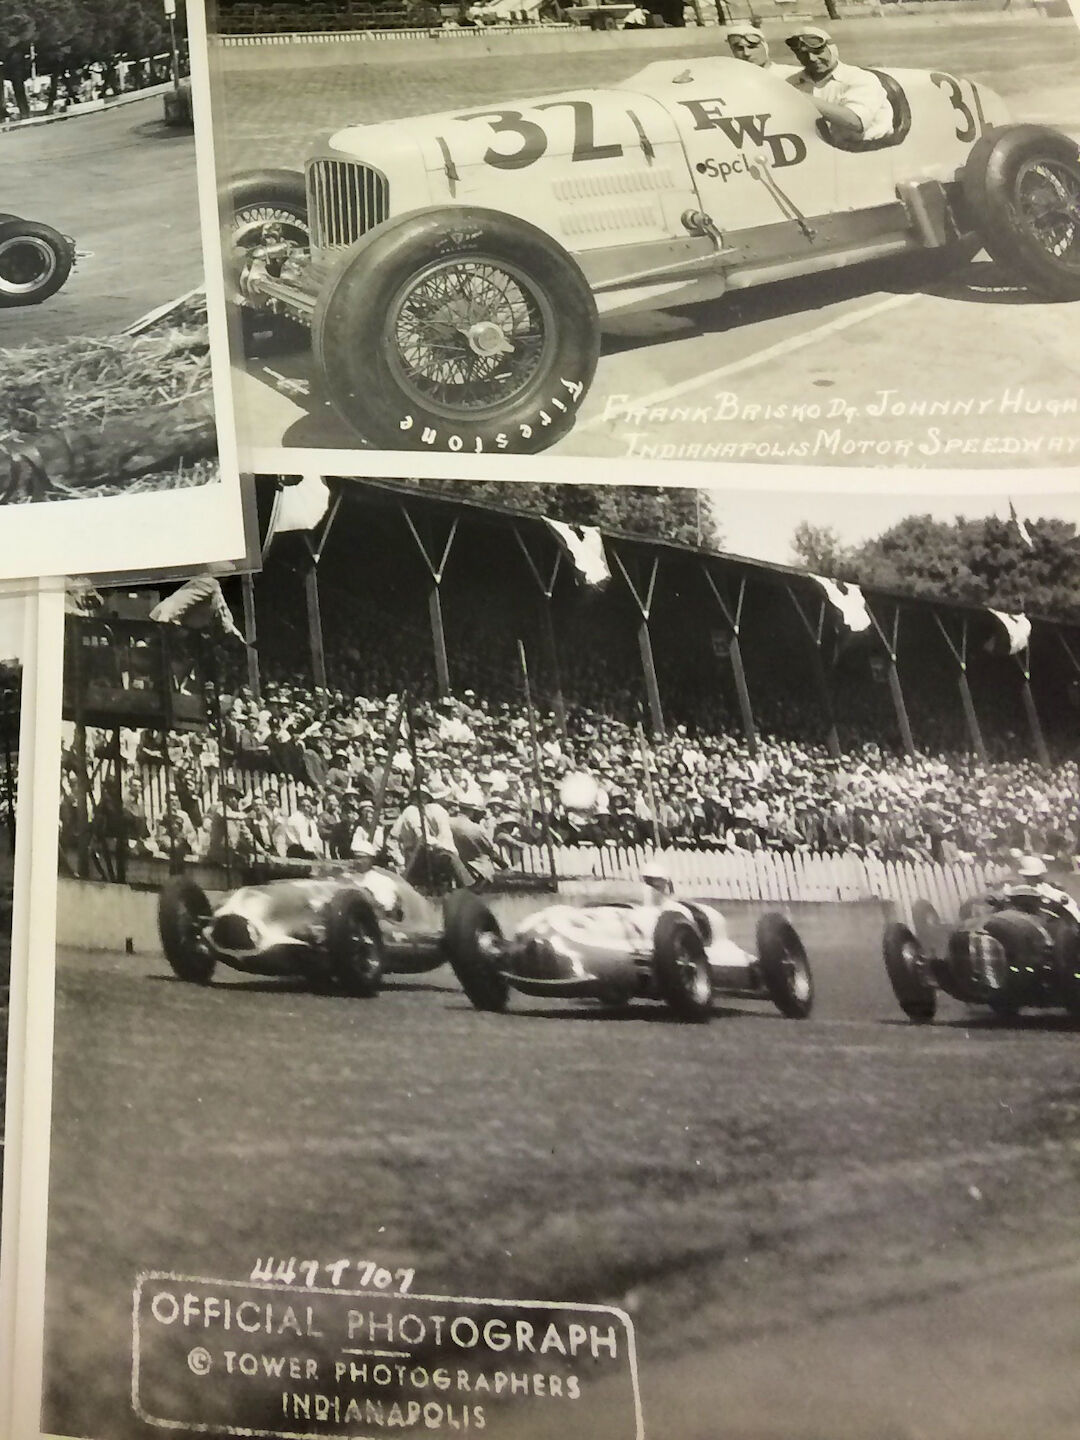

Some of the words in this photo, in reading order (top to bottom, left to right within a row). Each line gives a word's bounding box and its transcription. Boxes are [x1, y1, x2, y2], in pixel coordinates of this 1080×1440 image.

[452, 101, 624, 170] 32
[677, 98, 807, 168] FWD
[400, 377, 584, 453] Firestone
[151, 1291, 324, 1337] OFFICIAL
[347, 1308, 617, 1359] PHOTOGRAPH
[224, 1350, 320, 1381] TOWER
[334, 1361, 581, 1400] PHOTOGRAPHERS
[282, 1392, 487, 1429] INDIANAPOLIS
